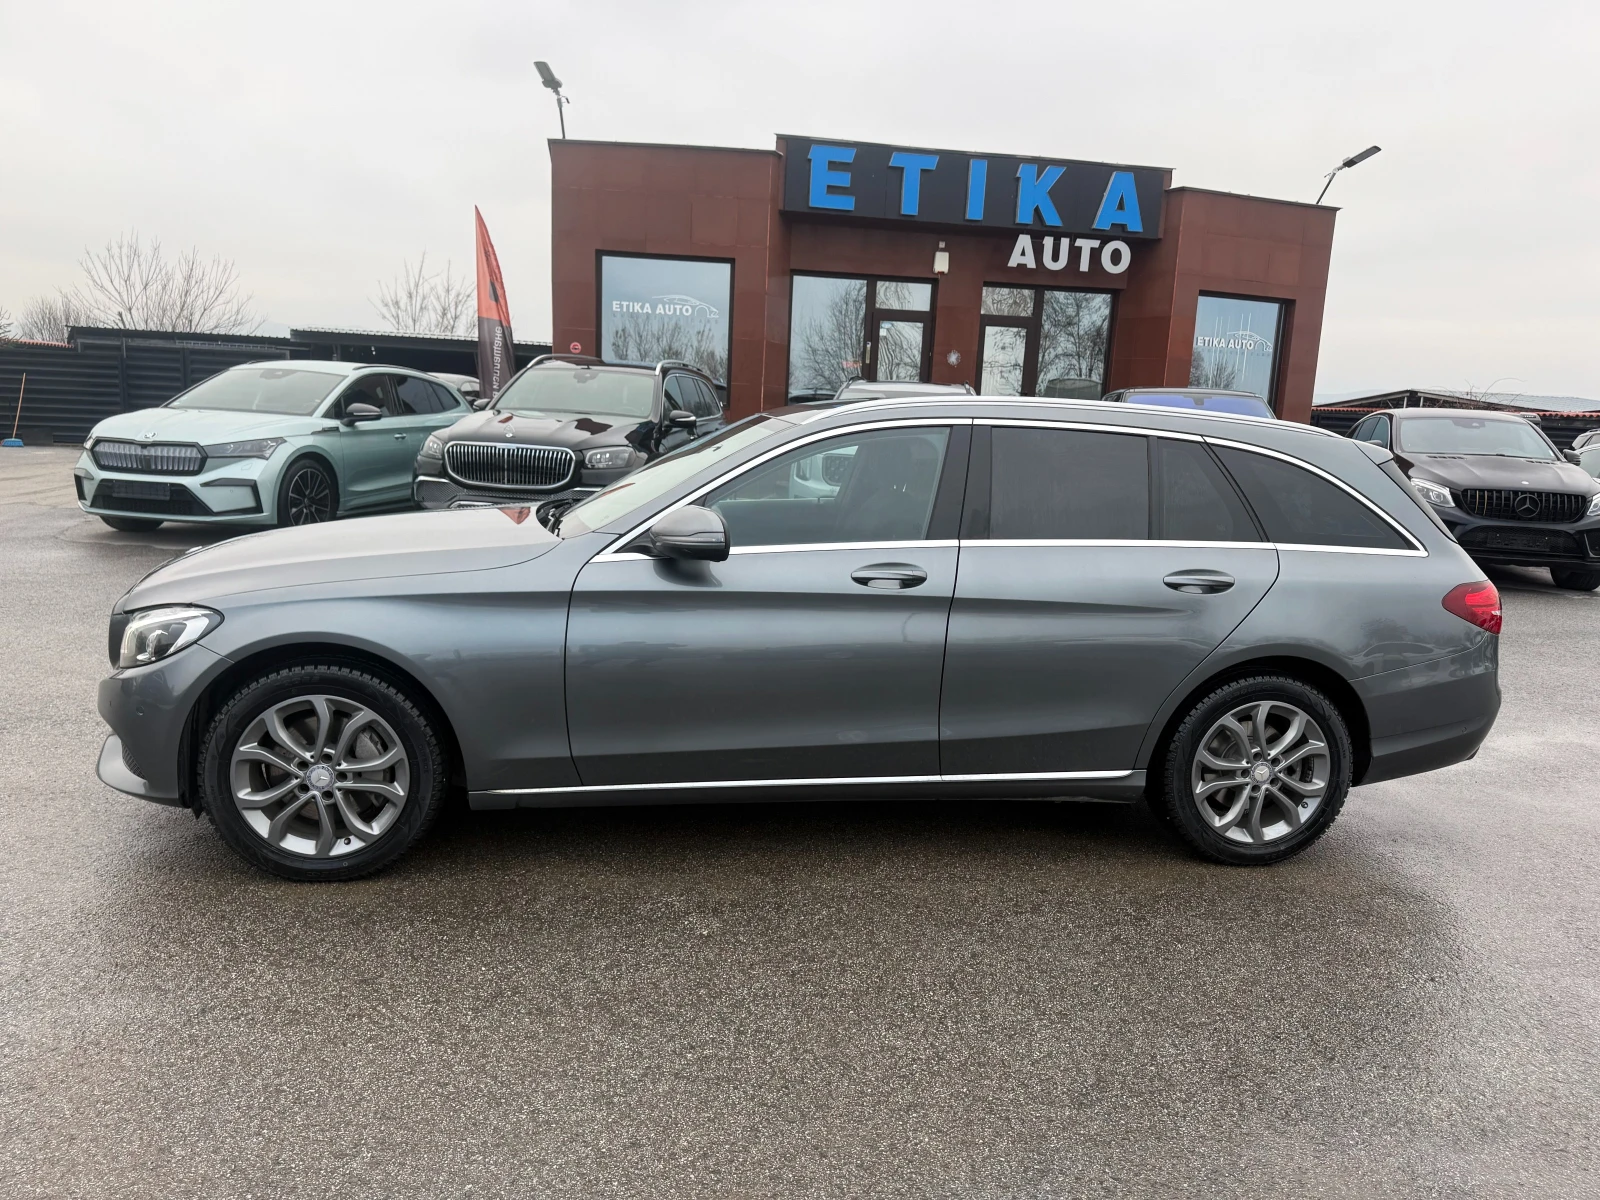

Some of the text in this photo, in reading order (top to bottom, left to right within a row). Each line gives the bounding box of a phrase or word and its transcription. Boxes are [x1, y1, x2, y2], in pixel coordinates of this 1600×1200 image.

[808, 144, 1143, 232] ETIKA
[1007, 234, 1132, 274] AUTO
[612, 300, 692, 316] ETIKA AUTO
[1197, 336, 1254, 350] ETIKA AUTO
